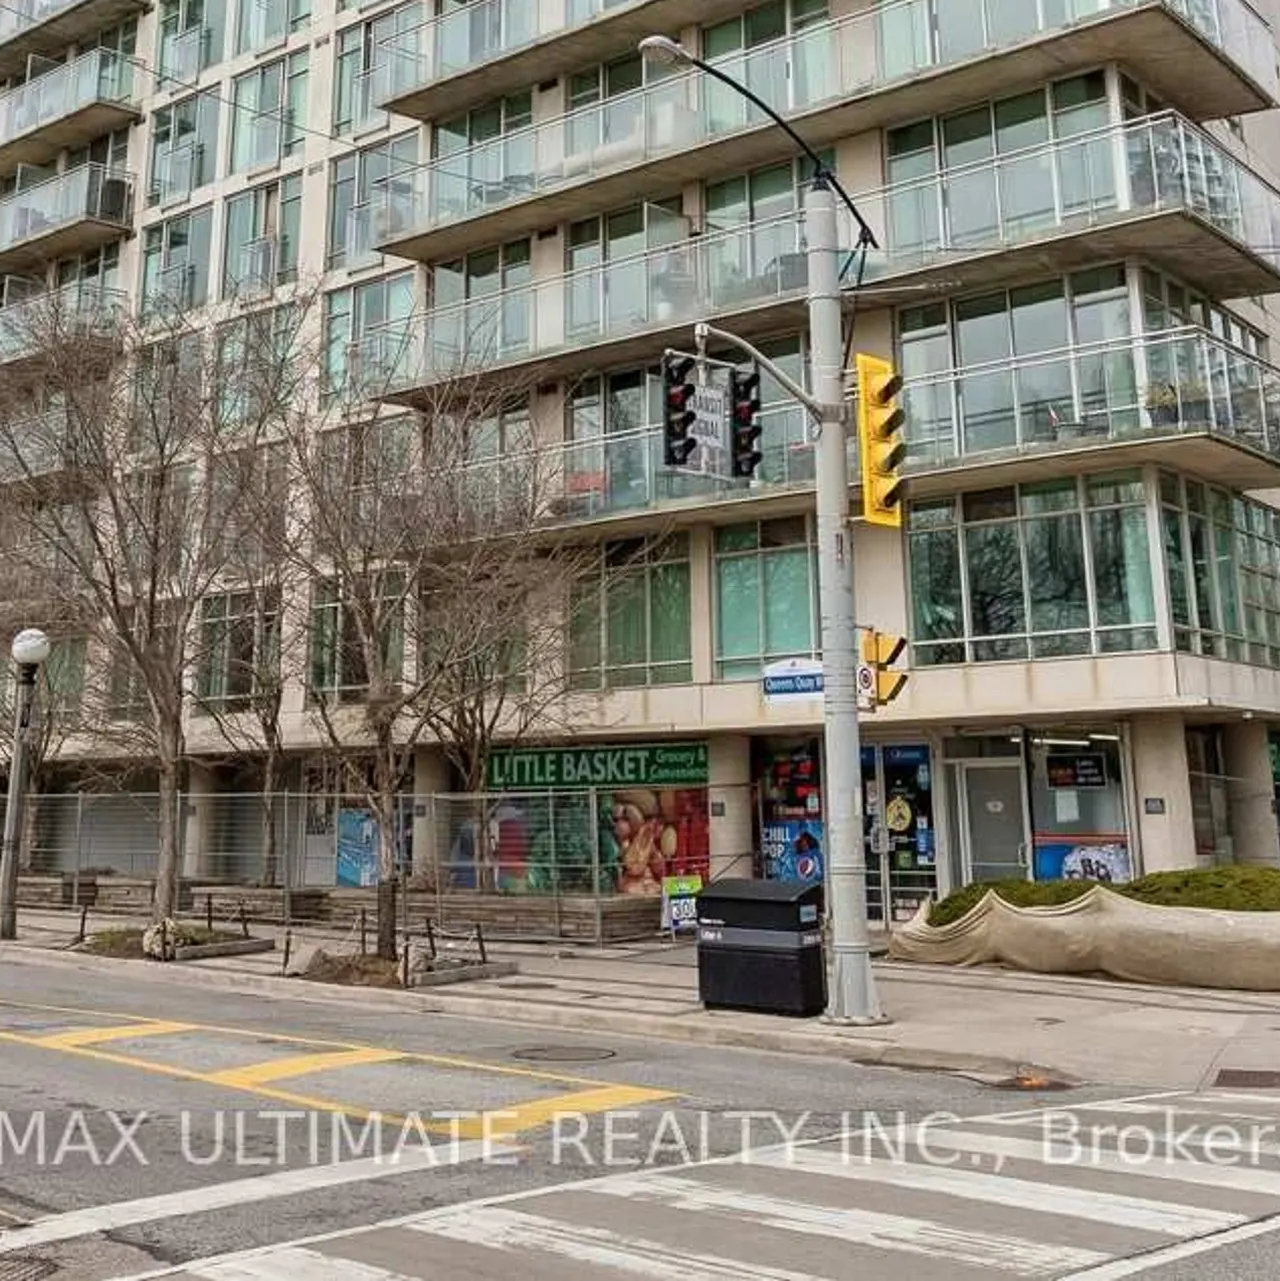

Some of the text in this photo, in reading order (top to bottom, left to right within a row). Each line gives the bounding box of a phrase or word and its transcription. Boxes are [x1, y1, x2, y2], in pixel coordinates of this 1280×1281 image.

[493, 750, 649, 783] LITTLE BASKET
[762, 826, 791, 842] CHILL
